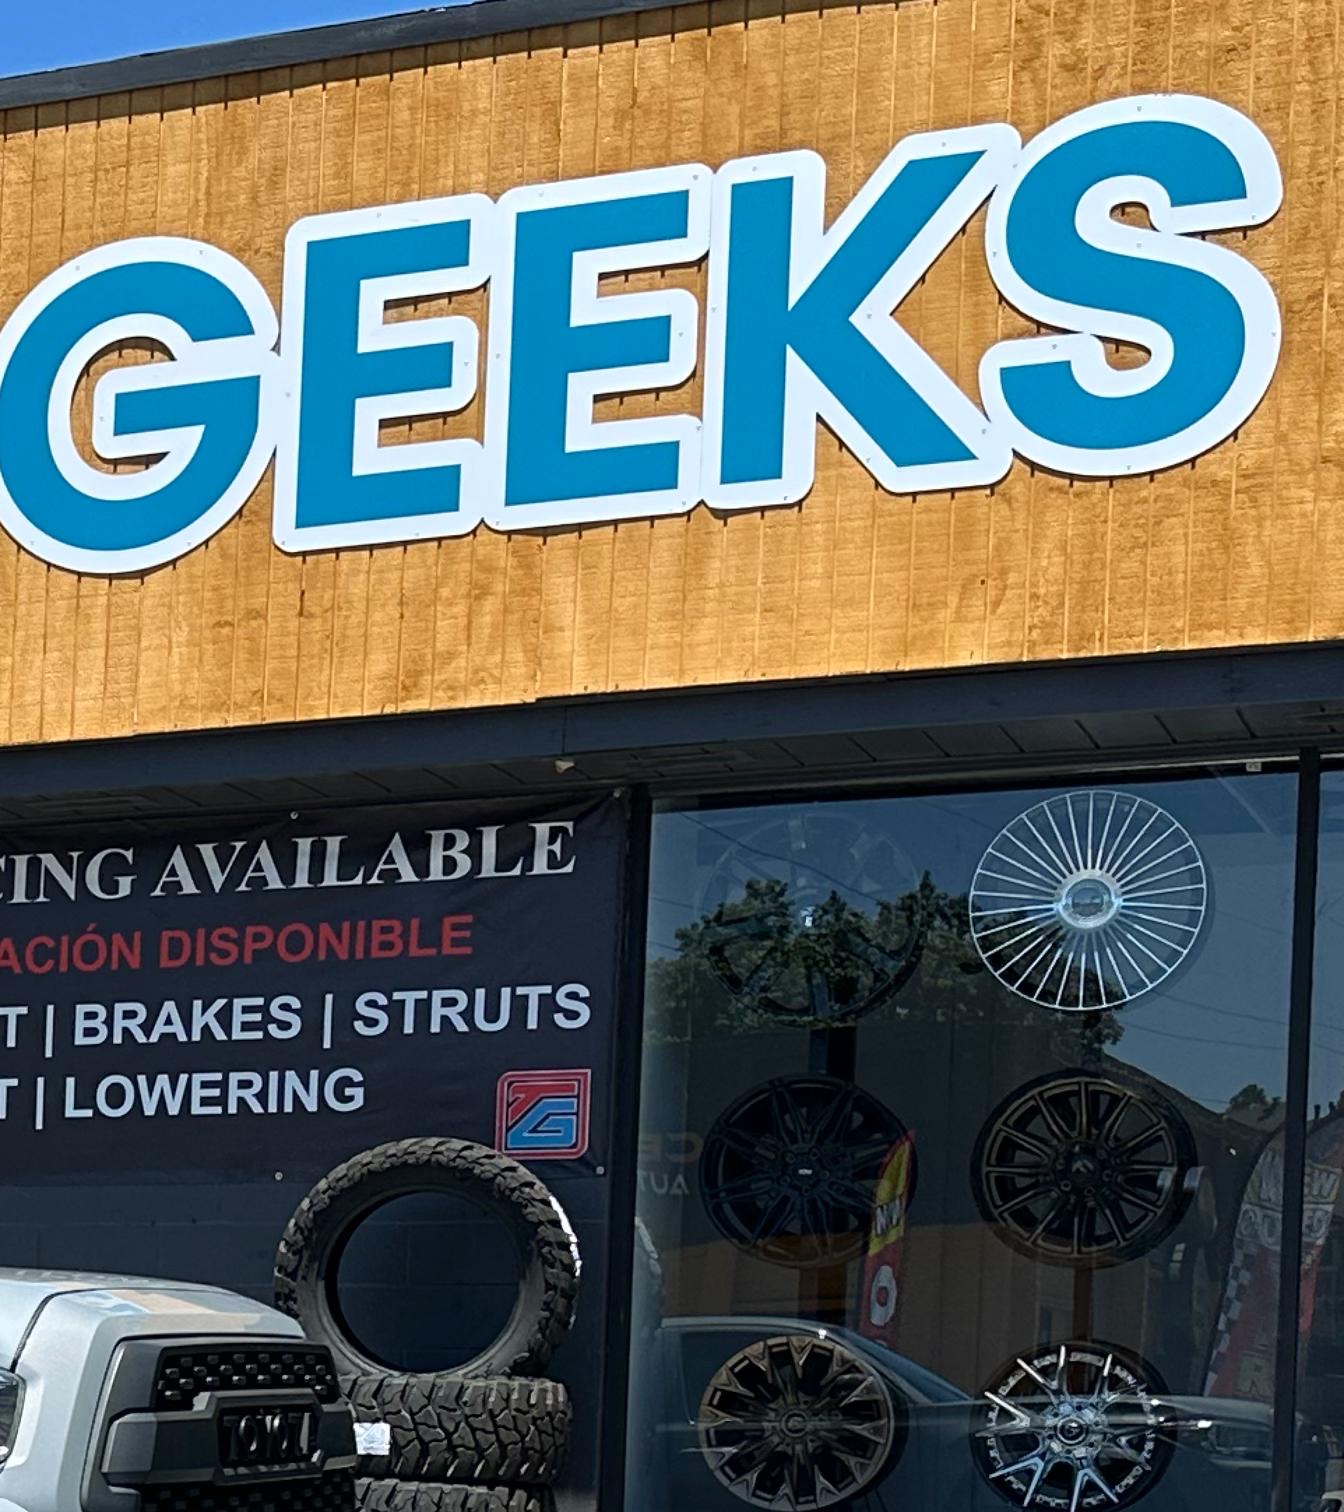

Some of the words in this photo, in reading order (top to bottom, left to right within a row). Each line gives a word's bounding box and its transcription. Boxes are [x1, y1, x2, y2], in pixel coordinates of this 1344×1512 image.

[150, 821, 576, 897] AVAILABLE
[159, 914, 474, 969] DISPONIBLE
[73, 994, 303, 1046] BRAKES
[352, 983, 592, 1037] STRUTS
[64, 1066, 365, 1119] LOWERING
